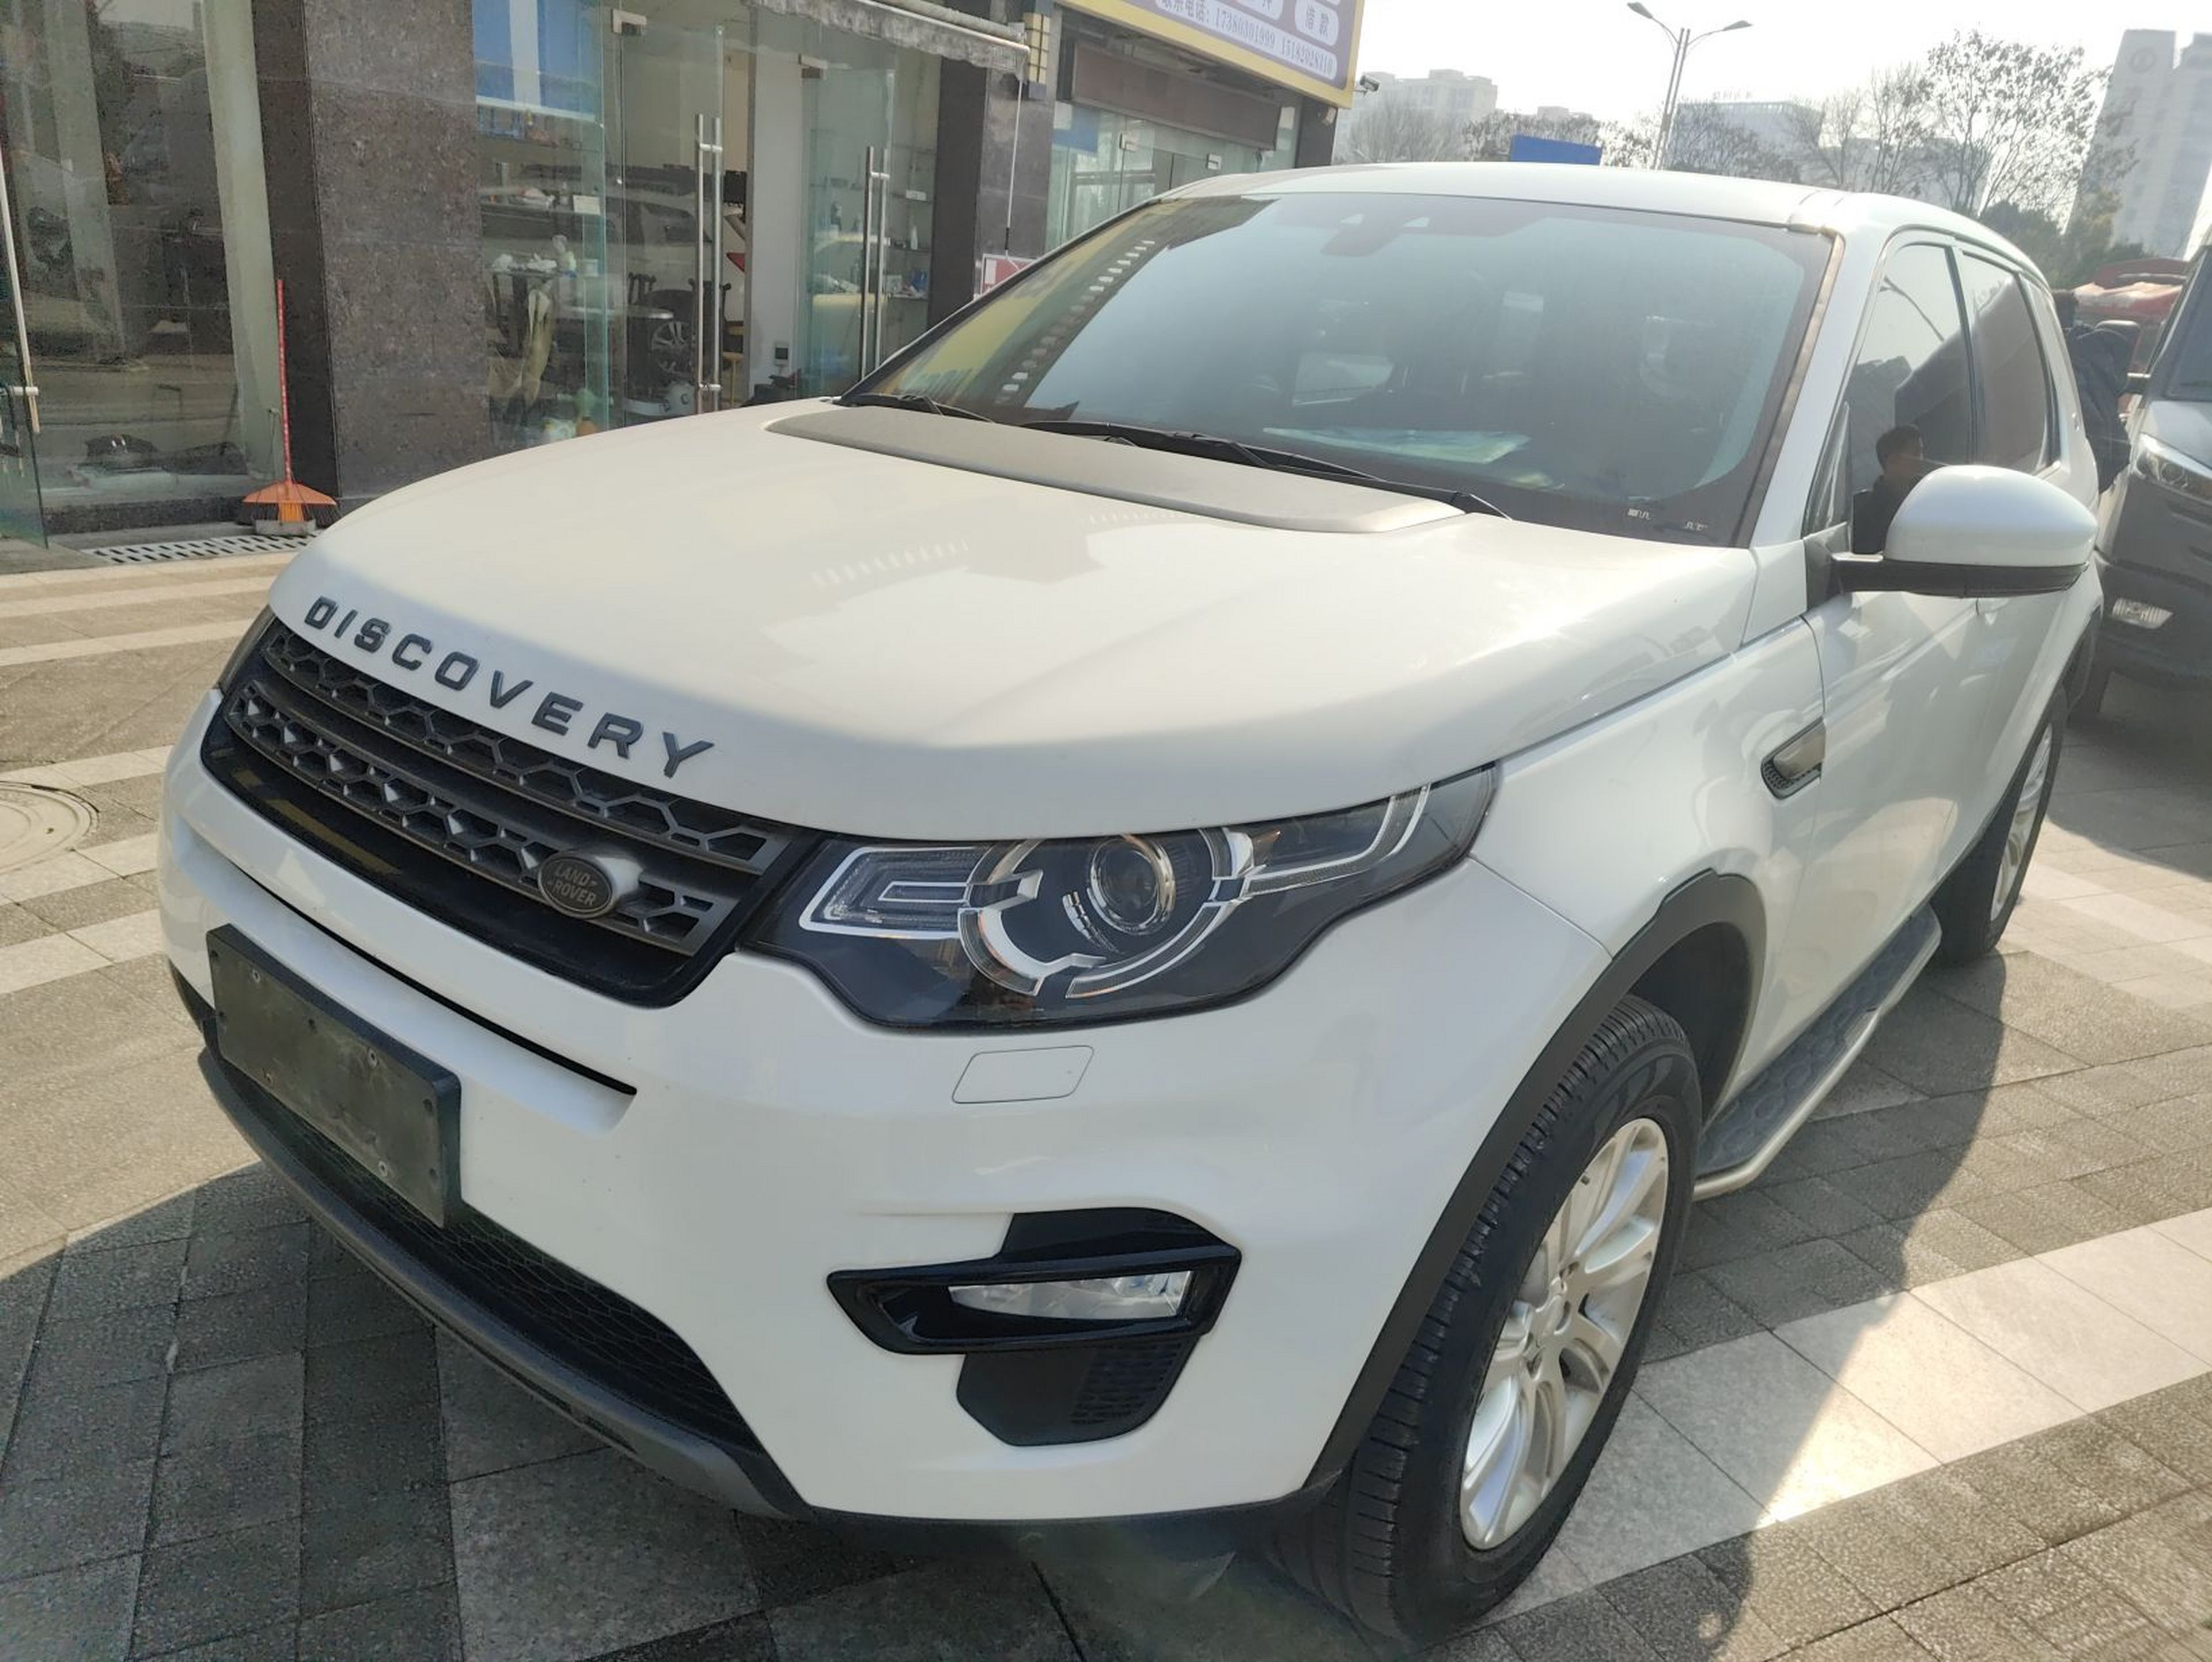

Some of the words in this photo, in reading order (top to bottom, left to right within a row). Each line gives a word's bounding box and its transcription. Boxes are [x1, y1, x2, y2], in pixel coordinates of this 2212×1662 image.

[304, 596, 714, 778] DISCOVERY
[555, 864, 590, 886] LAND
[552, 880, 596, 906] ROVER
